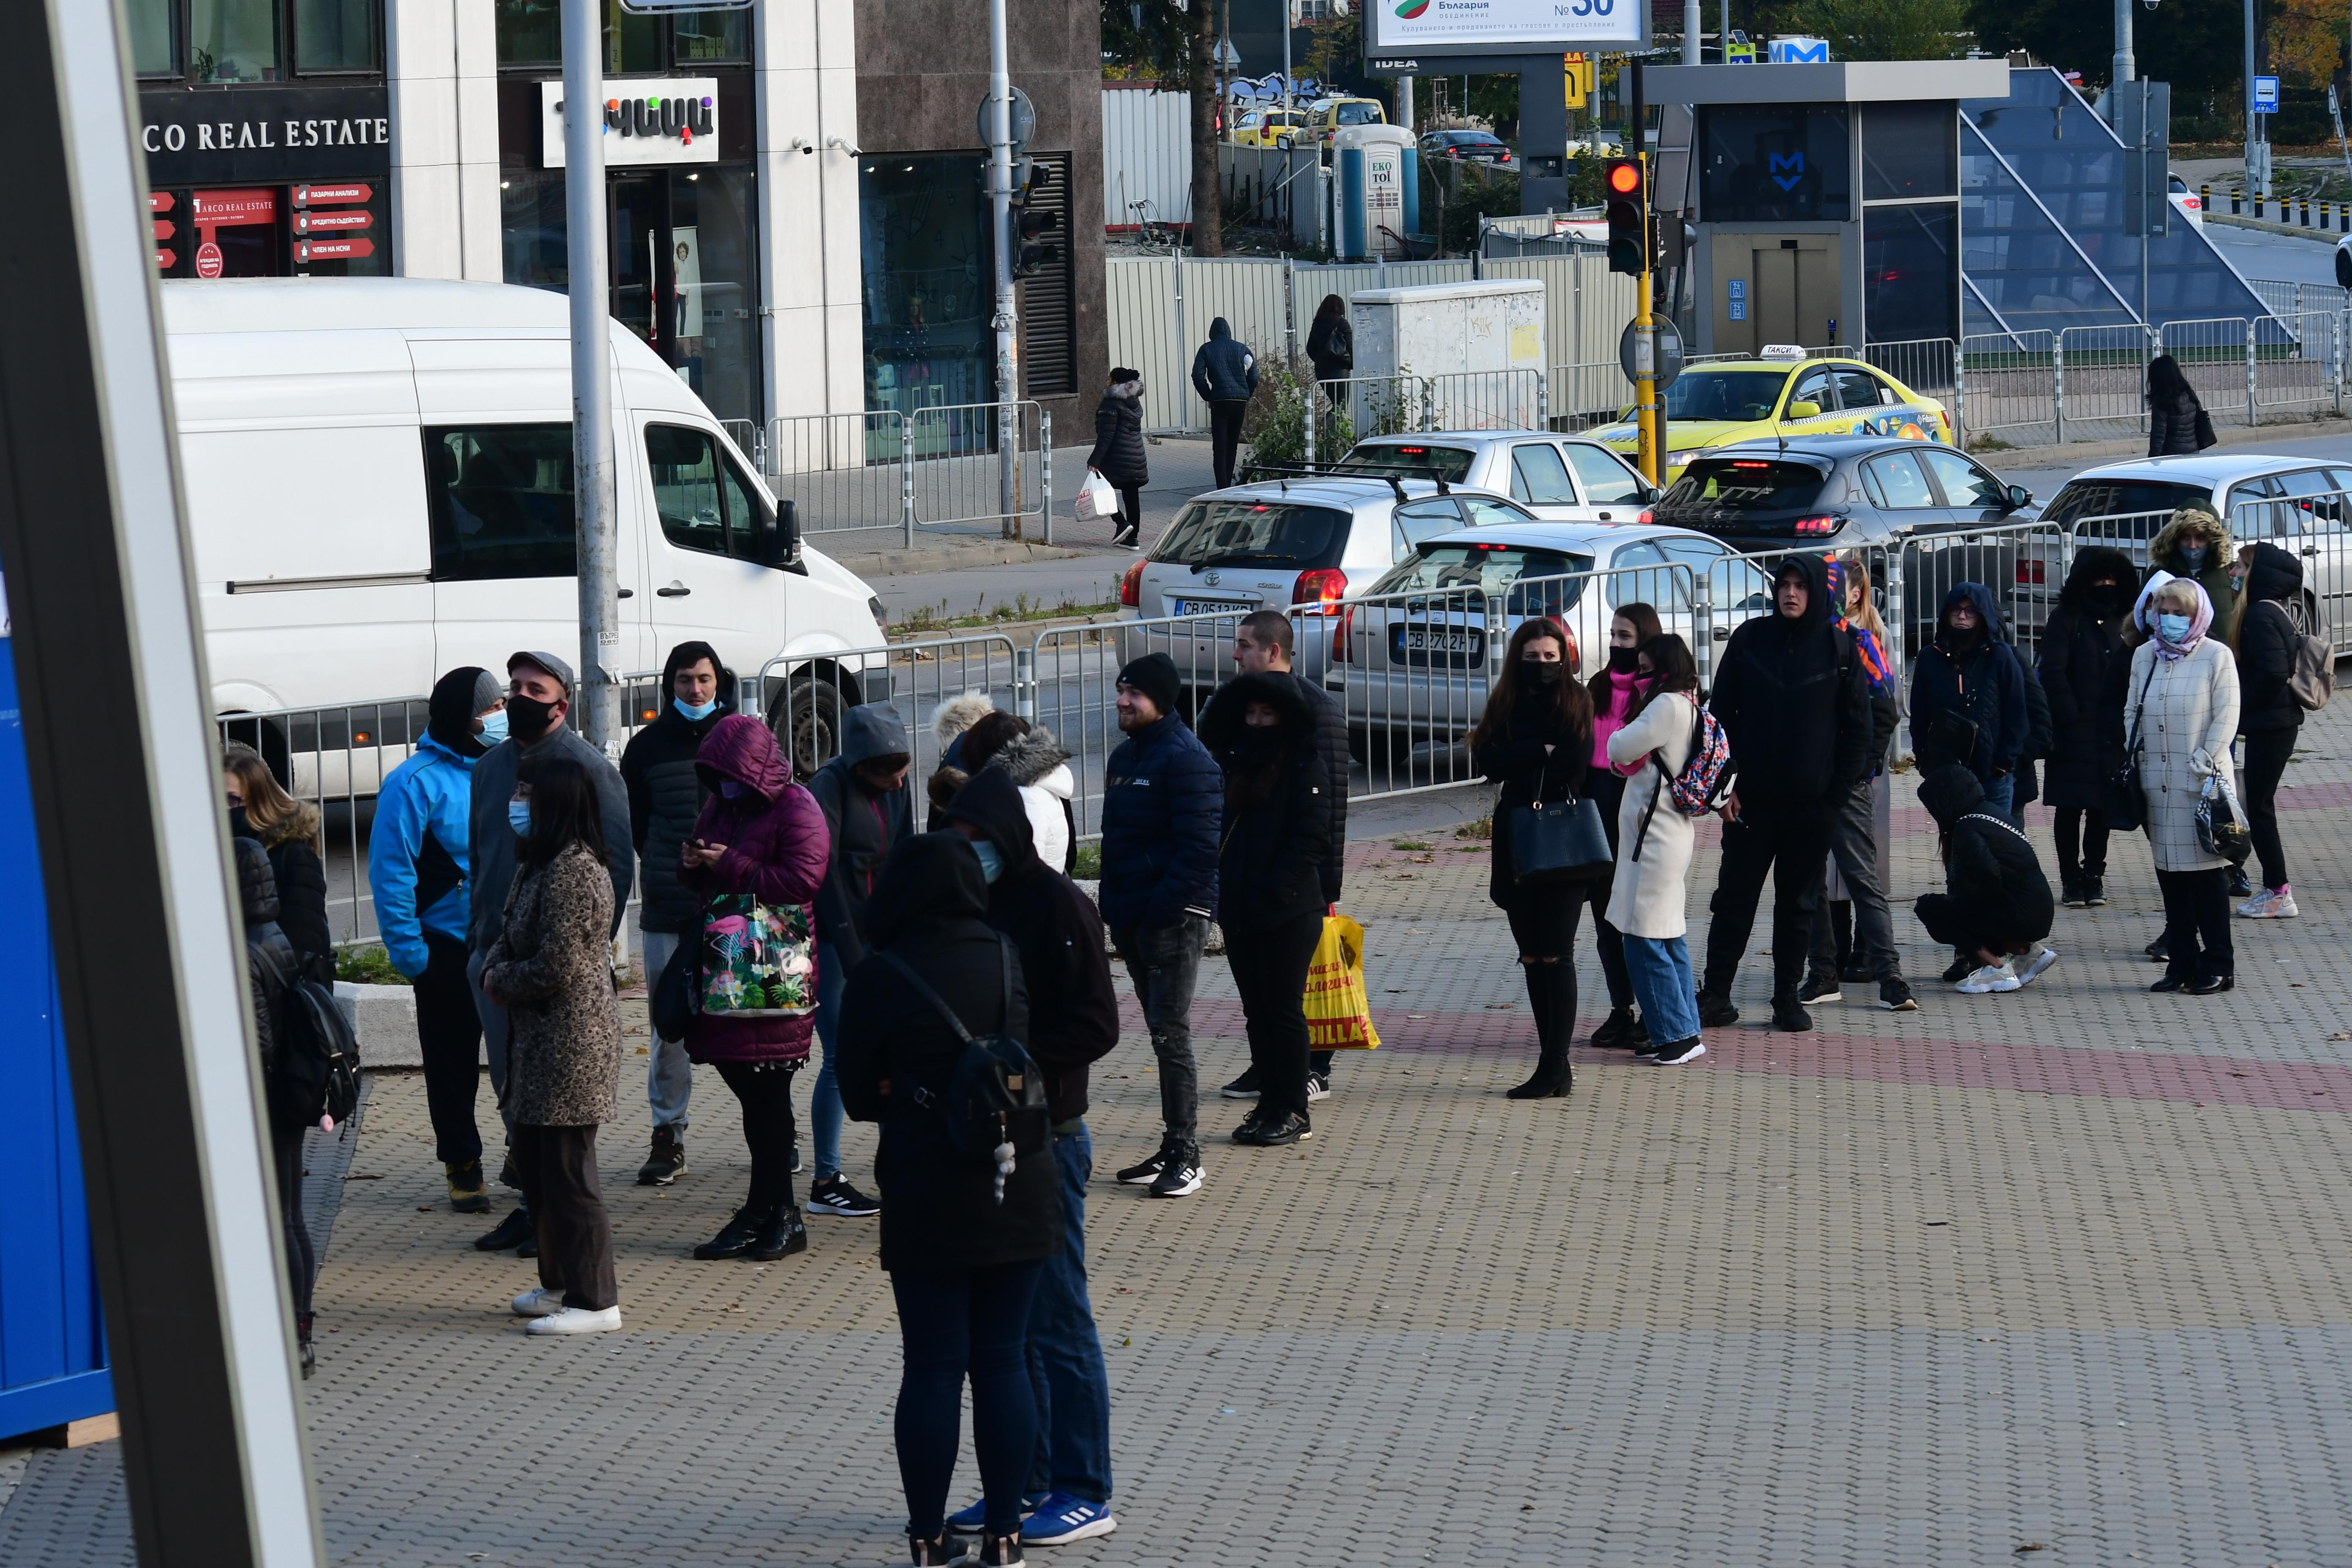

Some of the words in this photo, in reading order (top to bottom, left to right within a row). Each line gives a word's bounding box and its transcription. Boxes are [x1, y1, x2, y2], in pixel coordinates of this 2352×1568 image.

[1439, 1, 1489, 10] България
[1457, 24, 1505, 32] продаването
[1375, 60, 1418, 68] IDEA
[197, 122, 275, 150] REAL
[285, 118, 389, 147] ESTATE
[1372, 162, 1392, 171] EKO
[202, 204, 223, 212] ARCO
[226, 203, 245, 211] REAL
[247, 201, 272, 210] ESTATE
[1184, 602, 1199, 616] CB
[1408, 633, 1423, 647] CB
[1459, 634, 1476, 650] HT
[1308, 1022, 1364, 1045] BILLA
